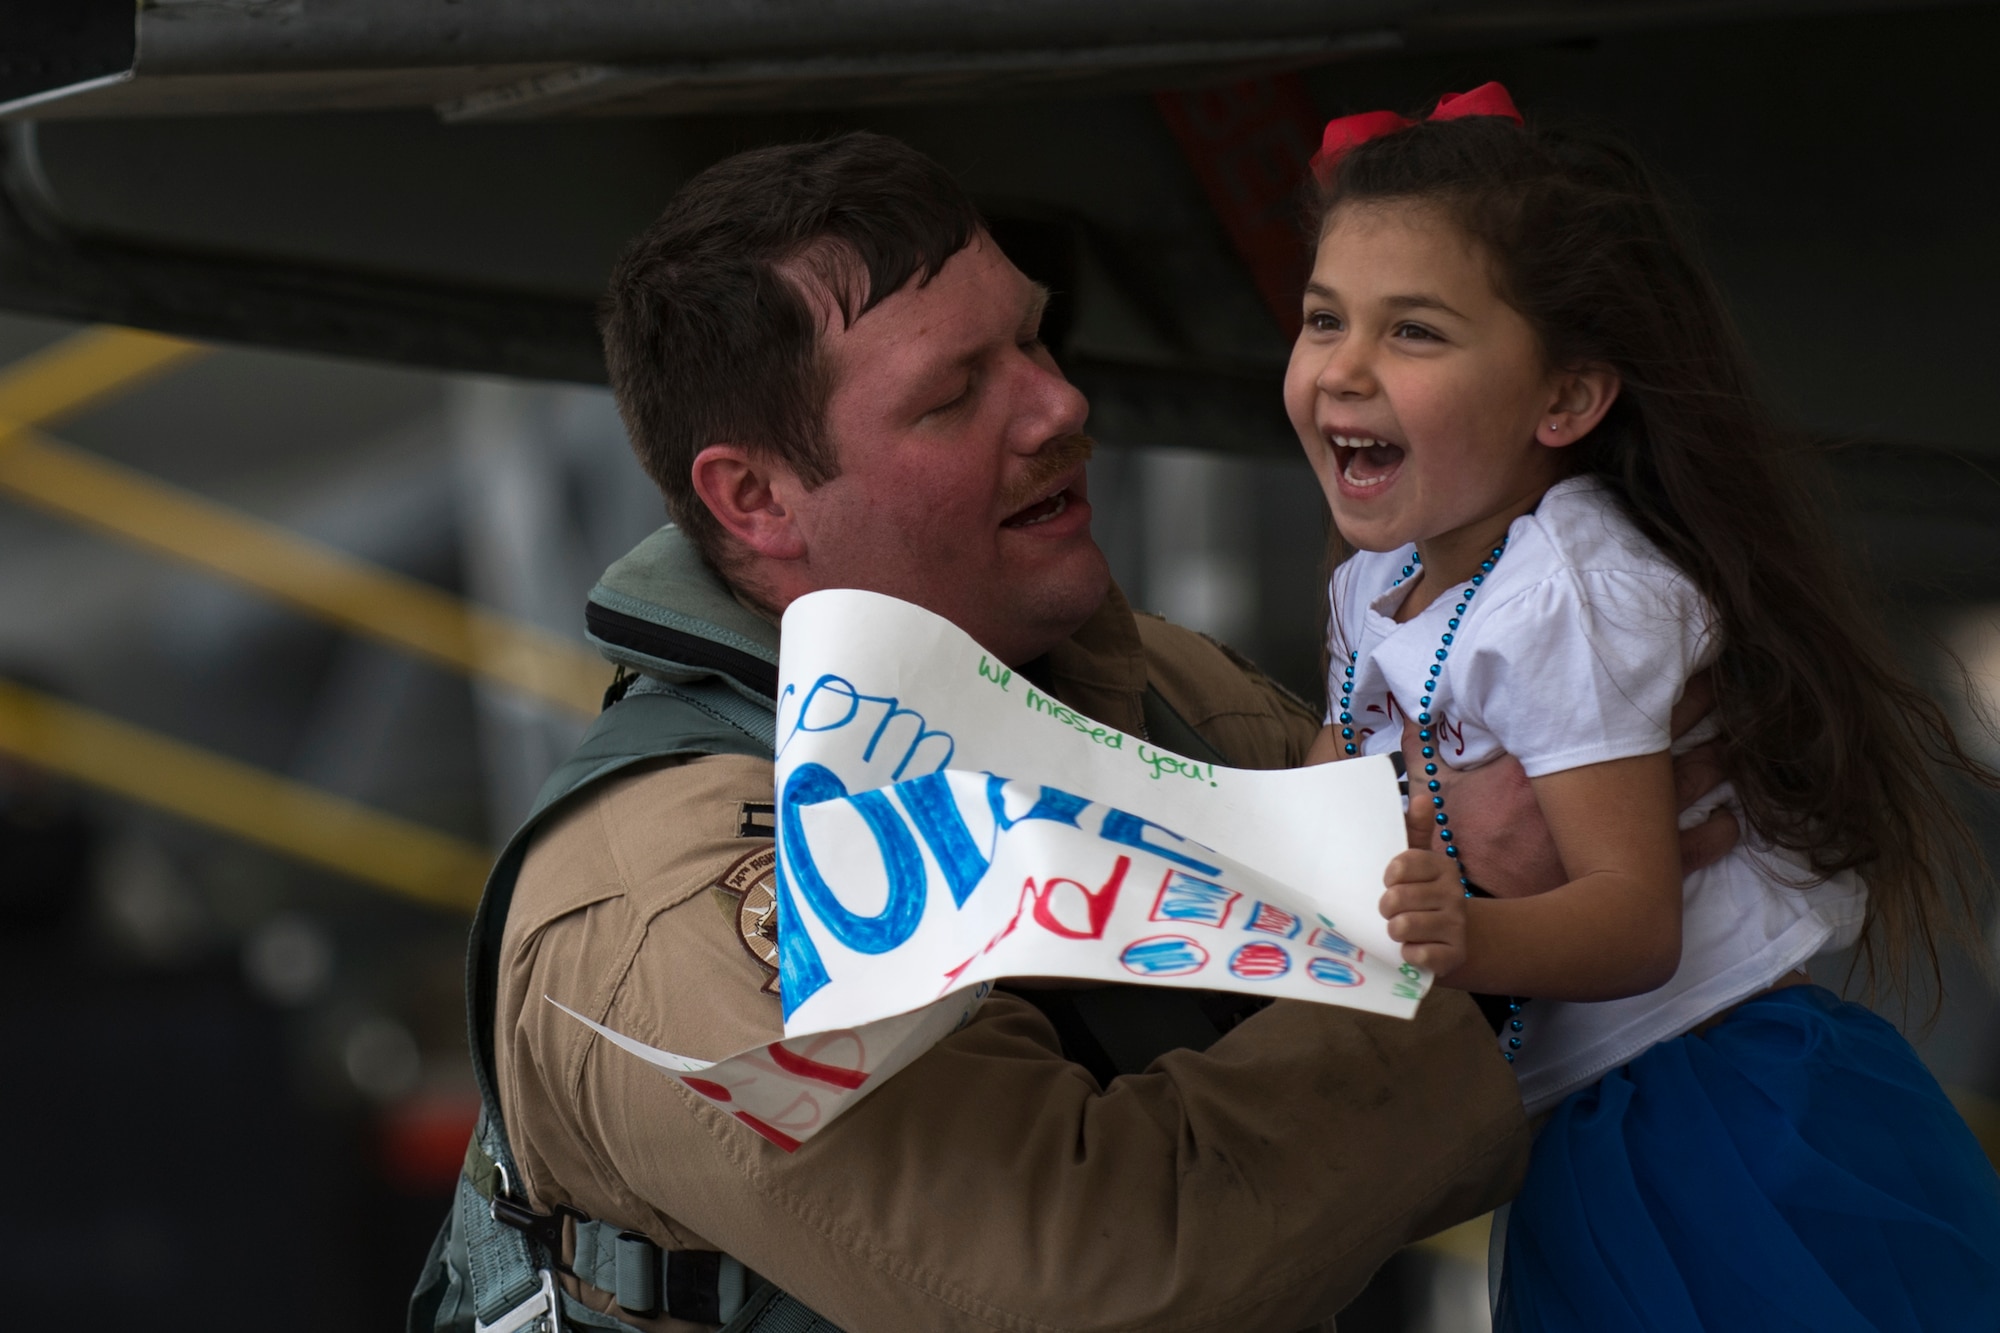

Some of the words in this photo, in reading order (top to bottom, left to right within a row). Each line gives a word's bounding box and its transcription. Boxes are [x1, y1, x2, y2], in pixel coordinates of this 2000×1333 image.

[977, 654, 1012, 693] We
[1025, 688, 1124, 751] missed
[1136, 744, 1219, 788] you!
